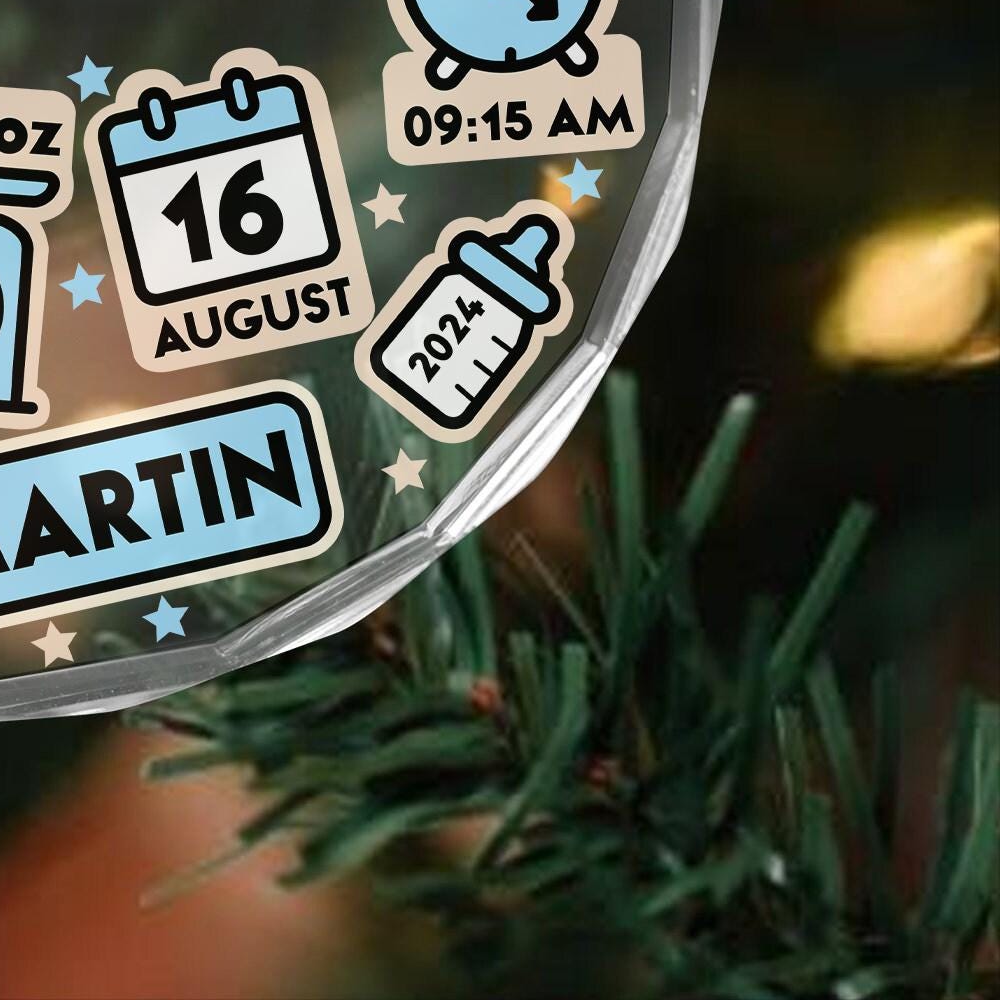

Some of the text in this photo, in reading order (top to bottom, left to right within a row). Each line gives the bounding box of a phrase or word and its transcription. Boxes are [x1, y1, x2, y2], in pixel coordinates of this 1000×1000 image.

[403, 94, 634, 147] 09:15 AM
[160, 159, 285, 264] 16
[154, 276, 352, 359] AUGUST
[408, 295, 486, 384] 2024
